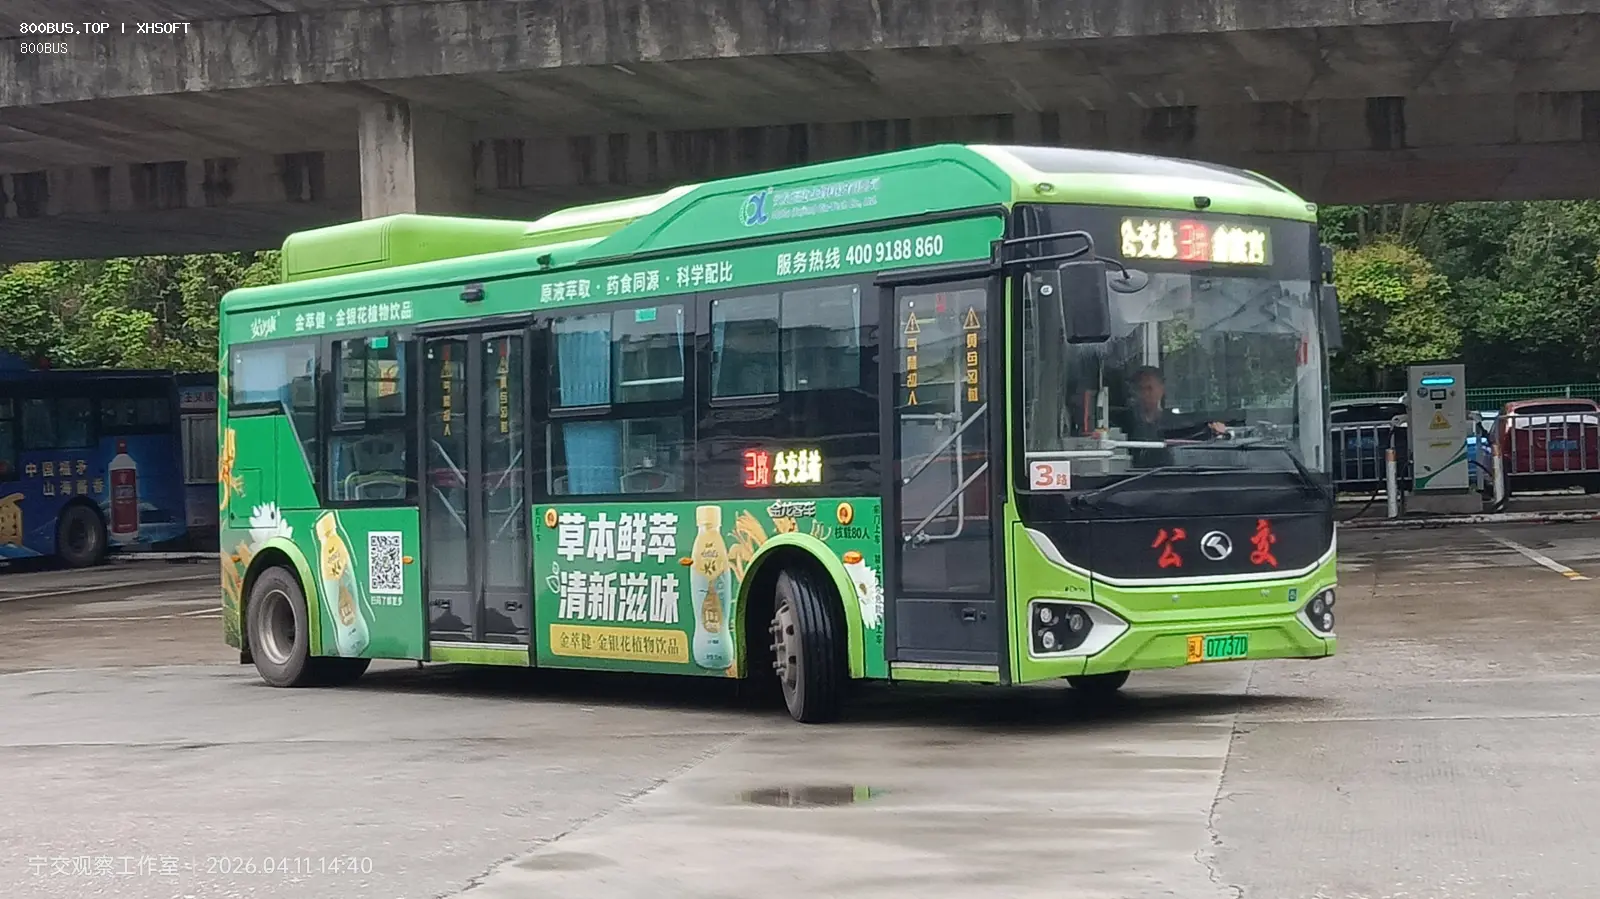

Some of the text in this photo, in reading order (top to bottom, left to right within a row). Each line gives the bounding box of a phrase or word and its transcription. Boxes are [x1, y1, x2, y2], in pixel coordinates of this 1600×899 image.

[776, 234, 944, 276] 服务热线 400 9188 860
[1035, 464, 1068, 486] 3路
[557, 512, 678, 563] 草本鲜萃
[558, 570, 679, 624] 清新滋味
